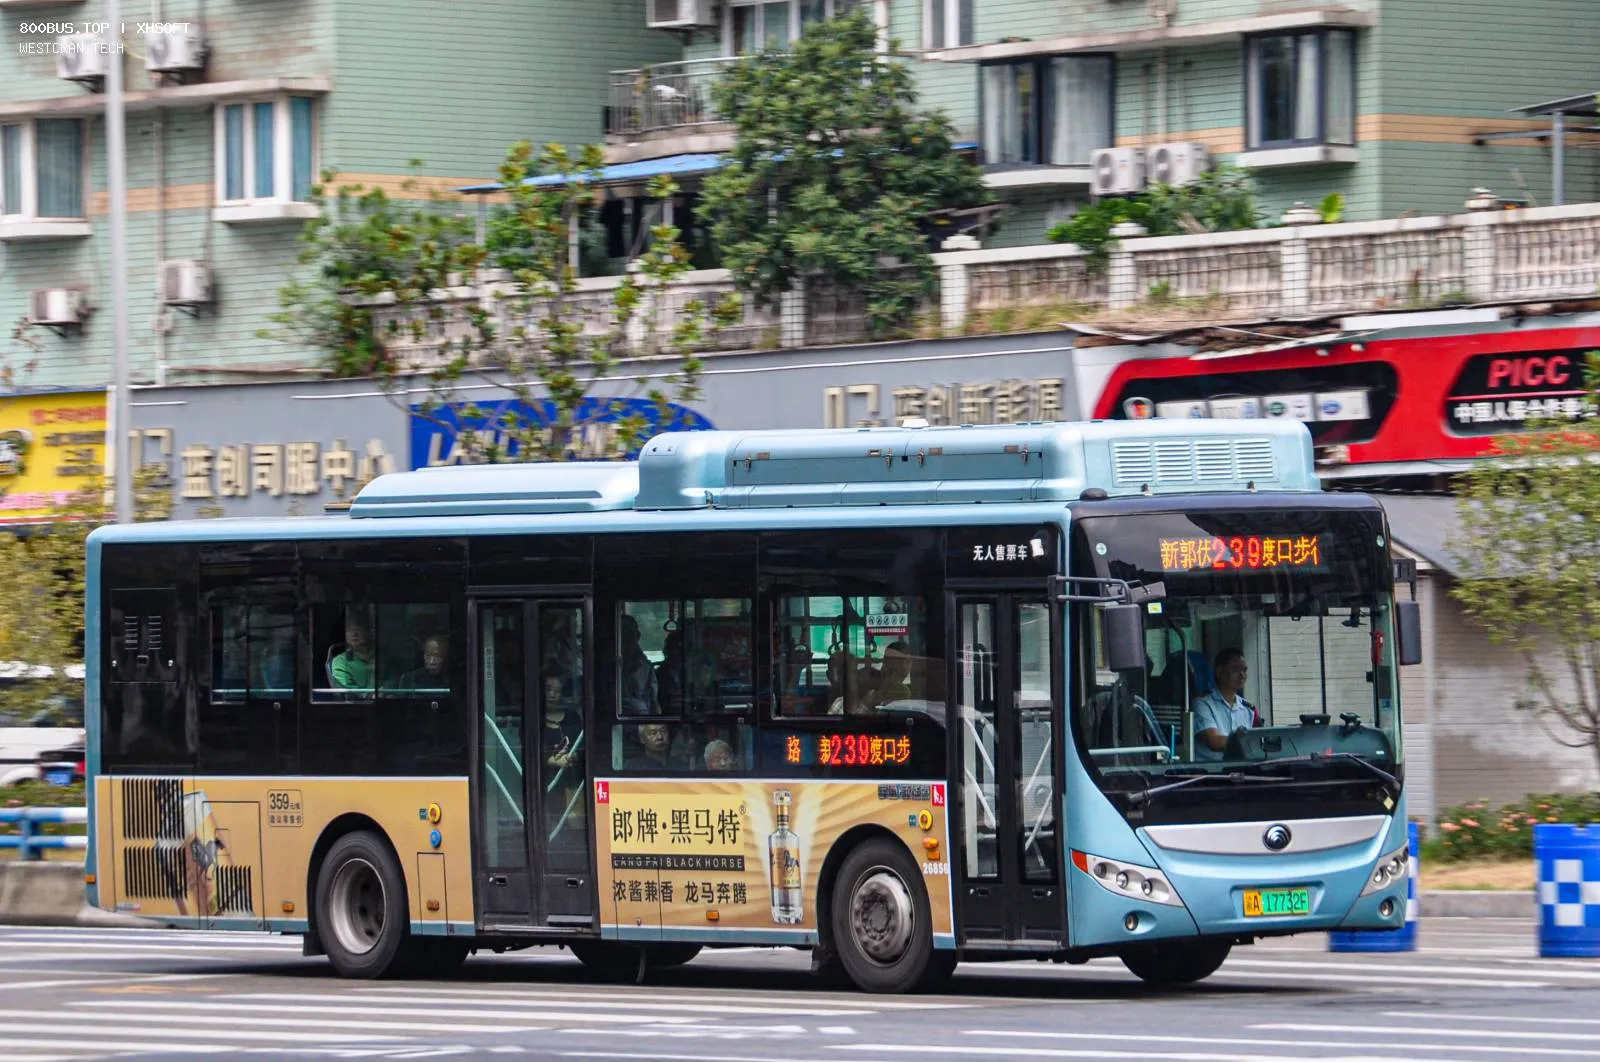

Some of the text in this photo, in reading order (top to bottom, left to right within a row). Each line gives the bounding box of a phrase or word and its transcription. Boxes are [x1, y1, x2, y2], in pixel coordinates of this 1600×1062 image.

[1487, 355, 1571, 388] PICC
[973, 544, 1028, 561] 无人售票车
[612, 880, 747, 904] 浓酱兼香 龙马奔腾
